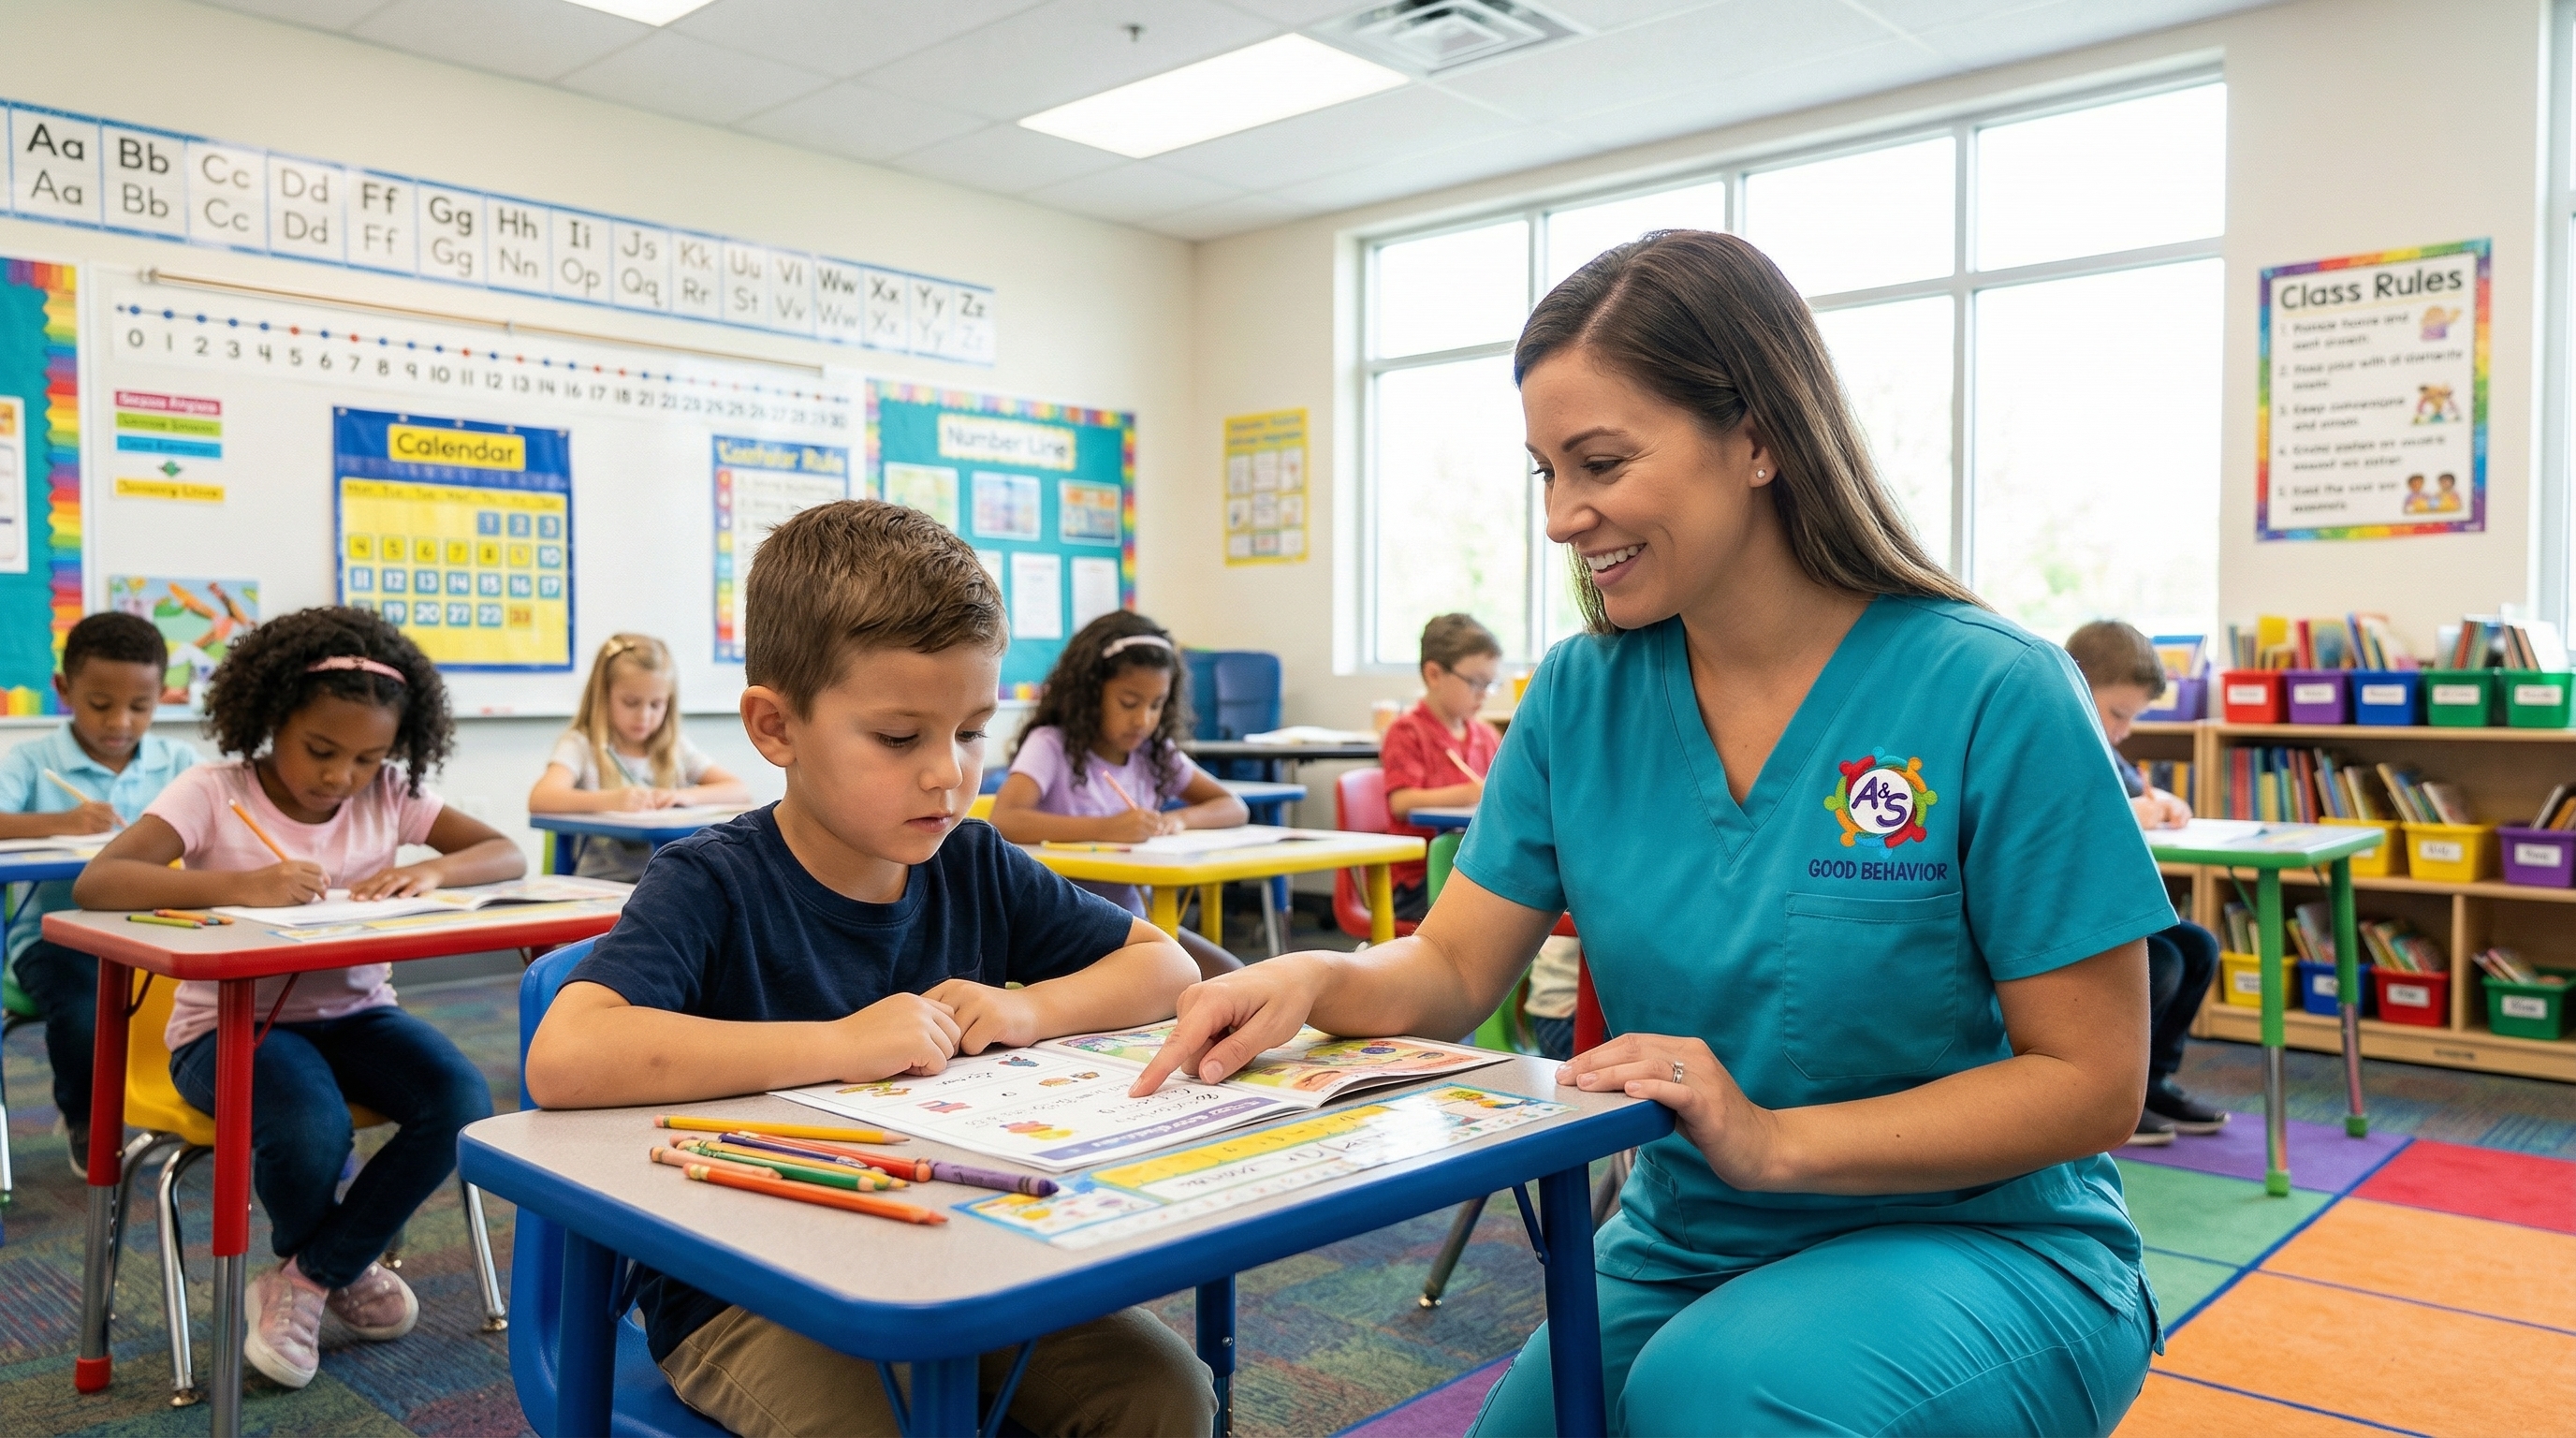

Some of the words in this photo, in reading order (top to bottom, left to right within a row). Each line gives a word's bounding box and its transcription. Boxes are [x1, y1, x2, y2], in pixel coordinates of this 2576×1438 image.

[26, 123, 84, 160] Aa
[119, 137, 169, 174] Bb
[201, 154, 250, 189] Cc
[282, 168, 328, 204] Dd
[362, 182, 399, 214] Ff
[429, 196, 473, 237] Gg
[498, 206, 538, 239] Hh
[570, 220, 590, 249] Ii
[680, 241, 711, 270] Kk
[729, 249, 761, 279] Uu
[817, 267, 856, 295] Ww
[871, 275, 899, 303] Xx
[916, 284, 944, 317] Yy
[960, 292, 985, 317] Zz
[31, 169, 82, 205] Aa
[122, 182, 168, 218] Bb
[204, 198, 249, 231] Cc
[284, 211, 328, 243] Dd
[364, 224, 398, 255] Ff
[432, 237, 473, 278] Gg
[500, 246, 538, 278] Nn
[562, 257, 600, 297] Op
[621, 267, 662, 307] Qq
[683, 277, 710, 306] Rr
[776, 294, 806, 320] Vv
[818, 301, 857, 328] Ww
[2280, 281, 2362, 309] Class
[2374, 269, 2463, 299] Rules
[128, 329, 144, 347] 0
[166, 333, 172, 351] 1
[195, 336, 208, 355] 2
[227, 340, 241, 360] 3
[258, 344, 271, 362] 4
[290, 347, 302, 366] 5
[320, 351, 331, 370] 6
[350, 355, 360, 373] 7
[377, 359, 389, 376] 8
[406, 362, 417, 381] 9
[431, 366, 451, 384] 10
[461, 370, 474, 387] 11
[486, 373, 502, 390] 12
[512, 375, 529, 392] 13
[538, 378, 555, 395] 14
[565, 381, 581, 398] 16
[590, 384, 606, 401] 17
[615, 387, 632, 404] 18
[397, 433, 515, 462] Calendar
[947, 425, 1020, 451] Number
[1031, 435, 1067, 462] Line
[1851, 776, 1908, 828] A&S
[1808, 858, 1856, 878] GOOD
[1861, 861, 1948, 882] BEHAVIOR
